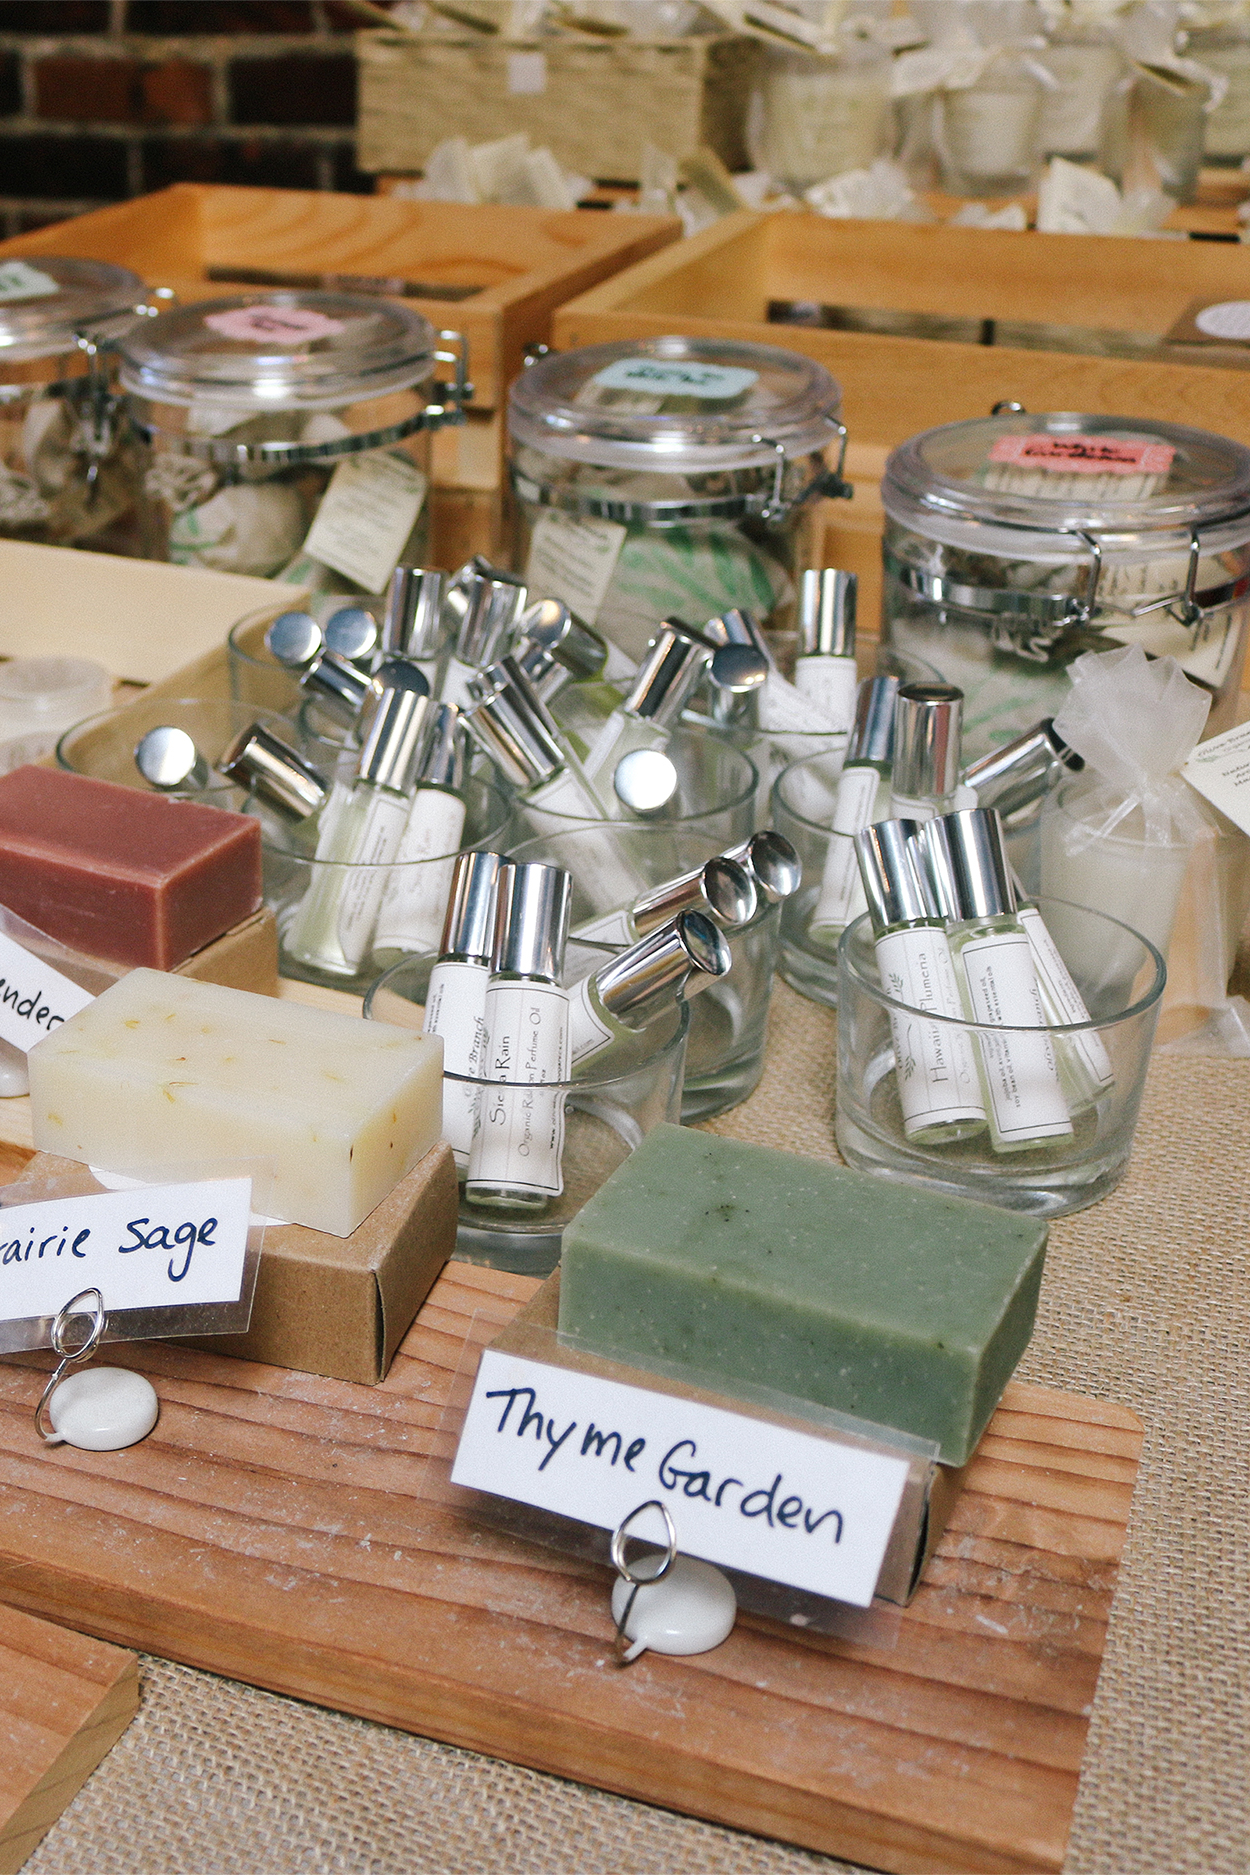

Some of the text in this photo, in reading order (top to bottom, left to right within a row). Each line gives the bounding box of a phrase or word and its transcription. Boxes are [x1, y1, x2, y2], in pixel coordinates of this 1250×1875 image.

[469, 1015, 485, 1064] Branch
[529, 1006, 541, 1026] Oil
[917, 952, 949, 1083] Hawaiia Plumeria
[525, 1030, 539, 1070] Perfume
[489, 1034, 511, 1126] Siea Rain
[518, 1111, 534, 1158] Organic
[485, 1386, 845, 1545] Thyme Garden
